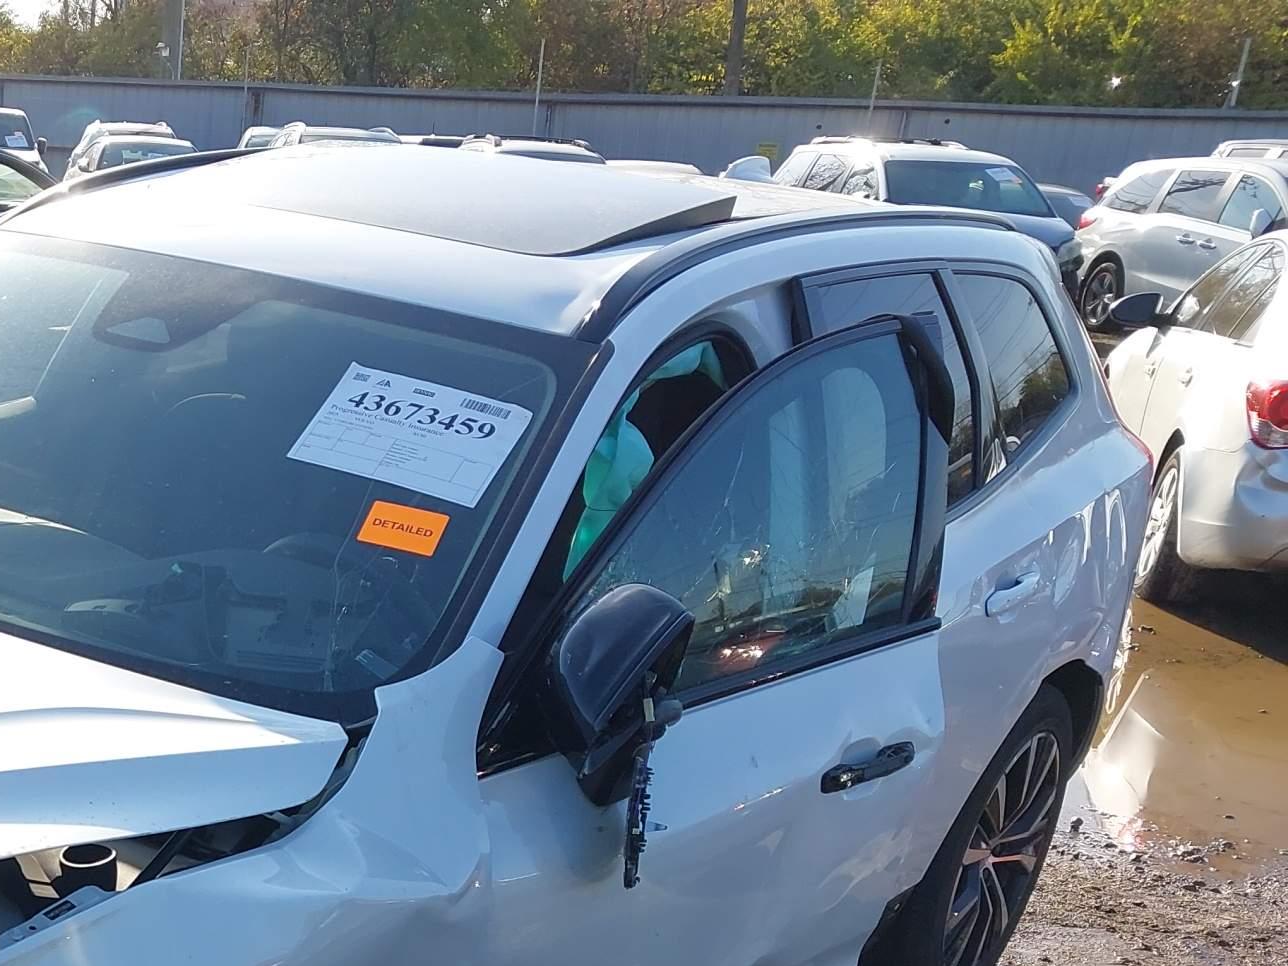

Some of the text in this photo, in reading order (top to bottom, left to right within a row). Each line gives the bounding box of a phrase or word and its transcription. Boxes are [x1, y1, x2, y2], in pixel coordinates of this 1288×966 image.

[331, 404, 372, 419] Progressive
[408, 423, 444, 437] Insurance
[348, 391, 496, 440] 43673459
[372, 518, 434, 538] DETAILED
